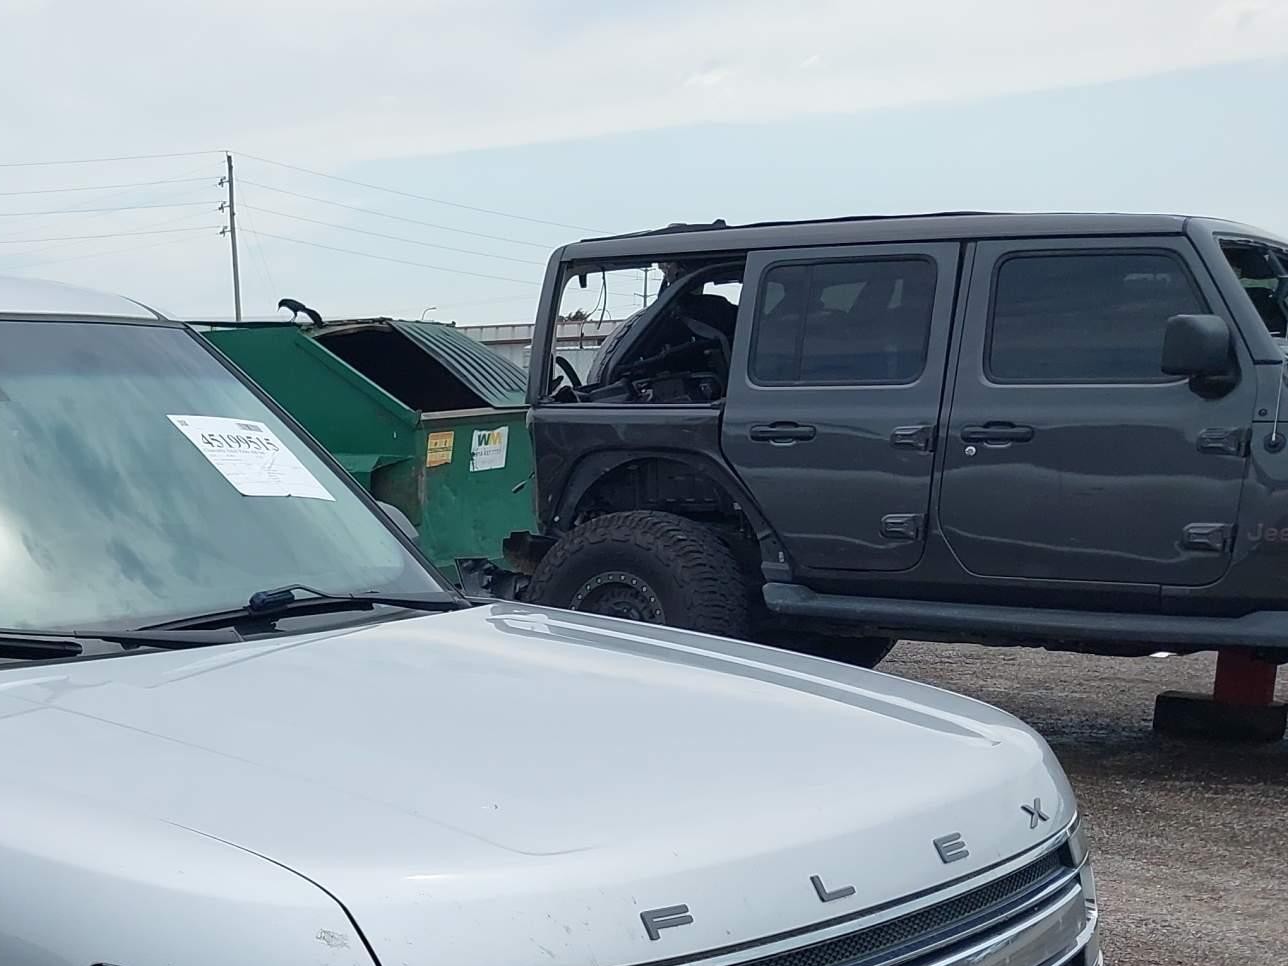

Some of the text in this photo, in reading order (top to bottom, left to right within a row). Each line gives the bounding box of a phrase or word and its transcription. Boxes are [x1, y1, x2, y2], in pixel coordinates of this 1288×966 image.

[200, 432, 280, 452] 45199515
[477, 431, 502, 447] WM
[640, 798, 1049, 941] FLEX
